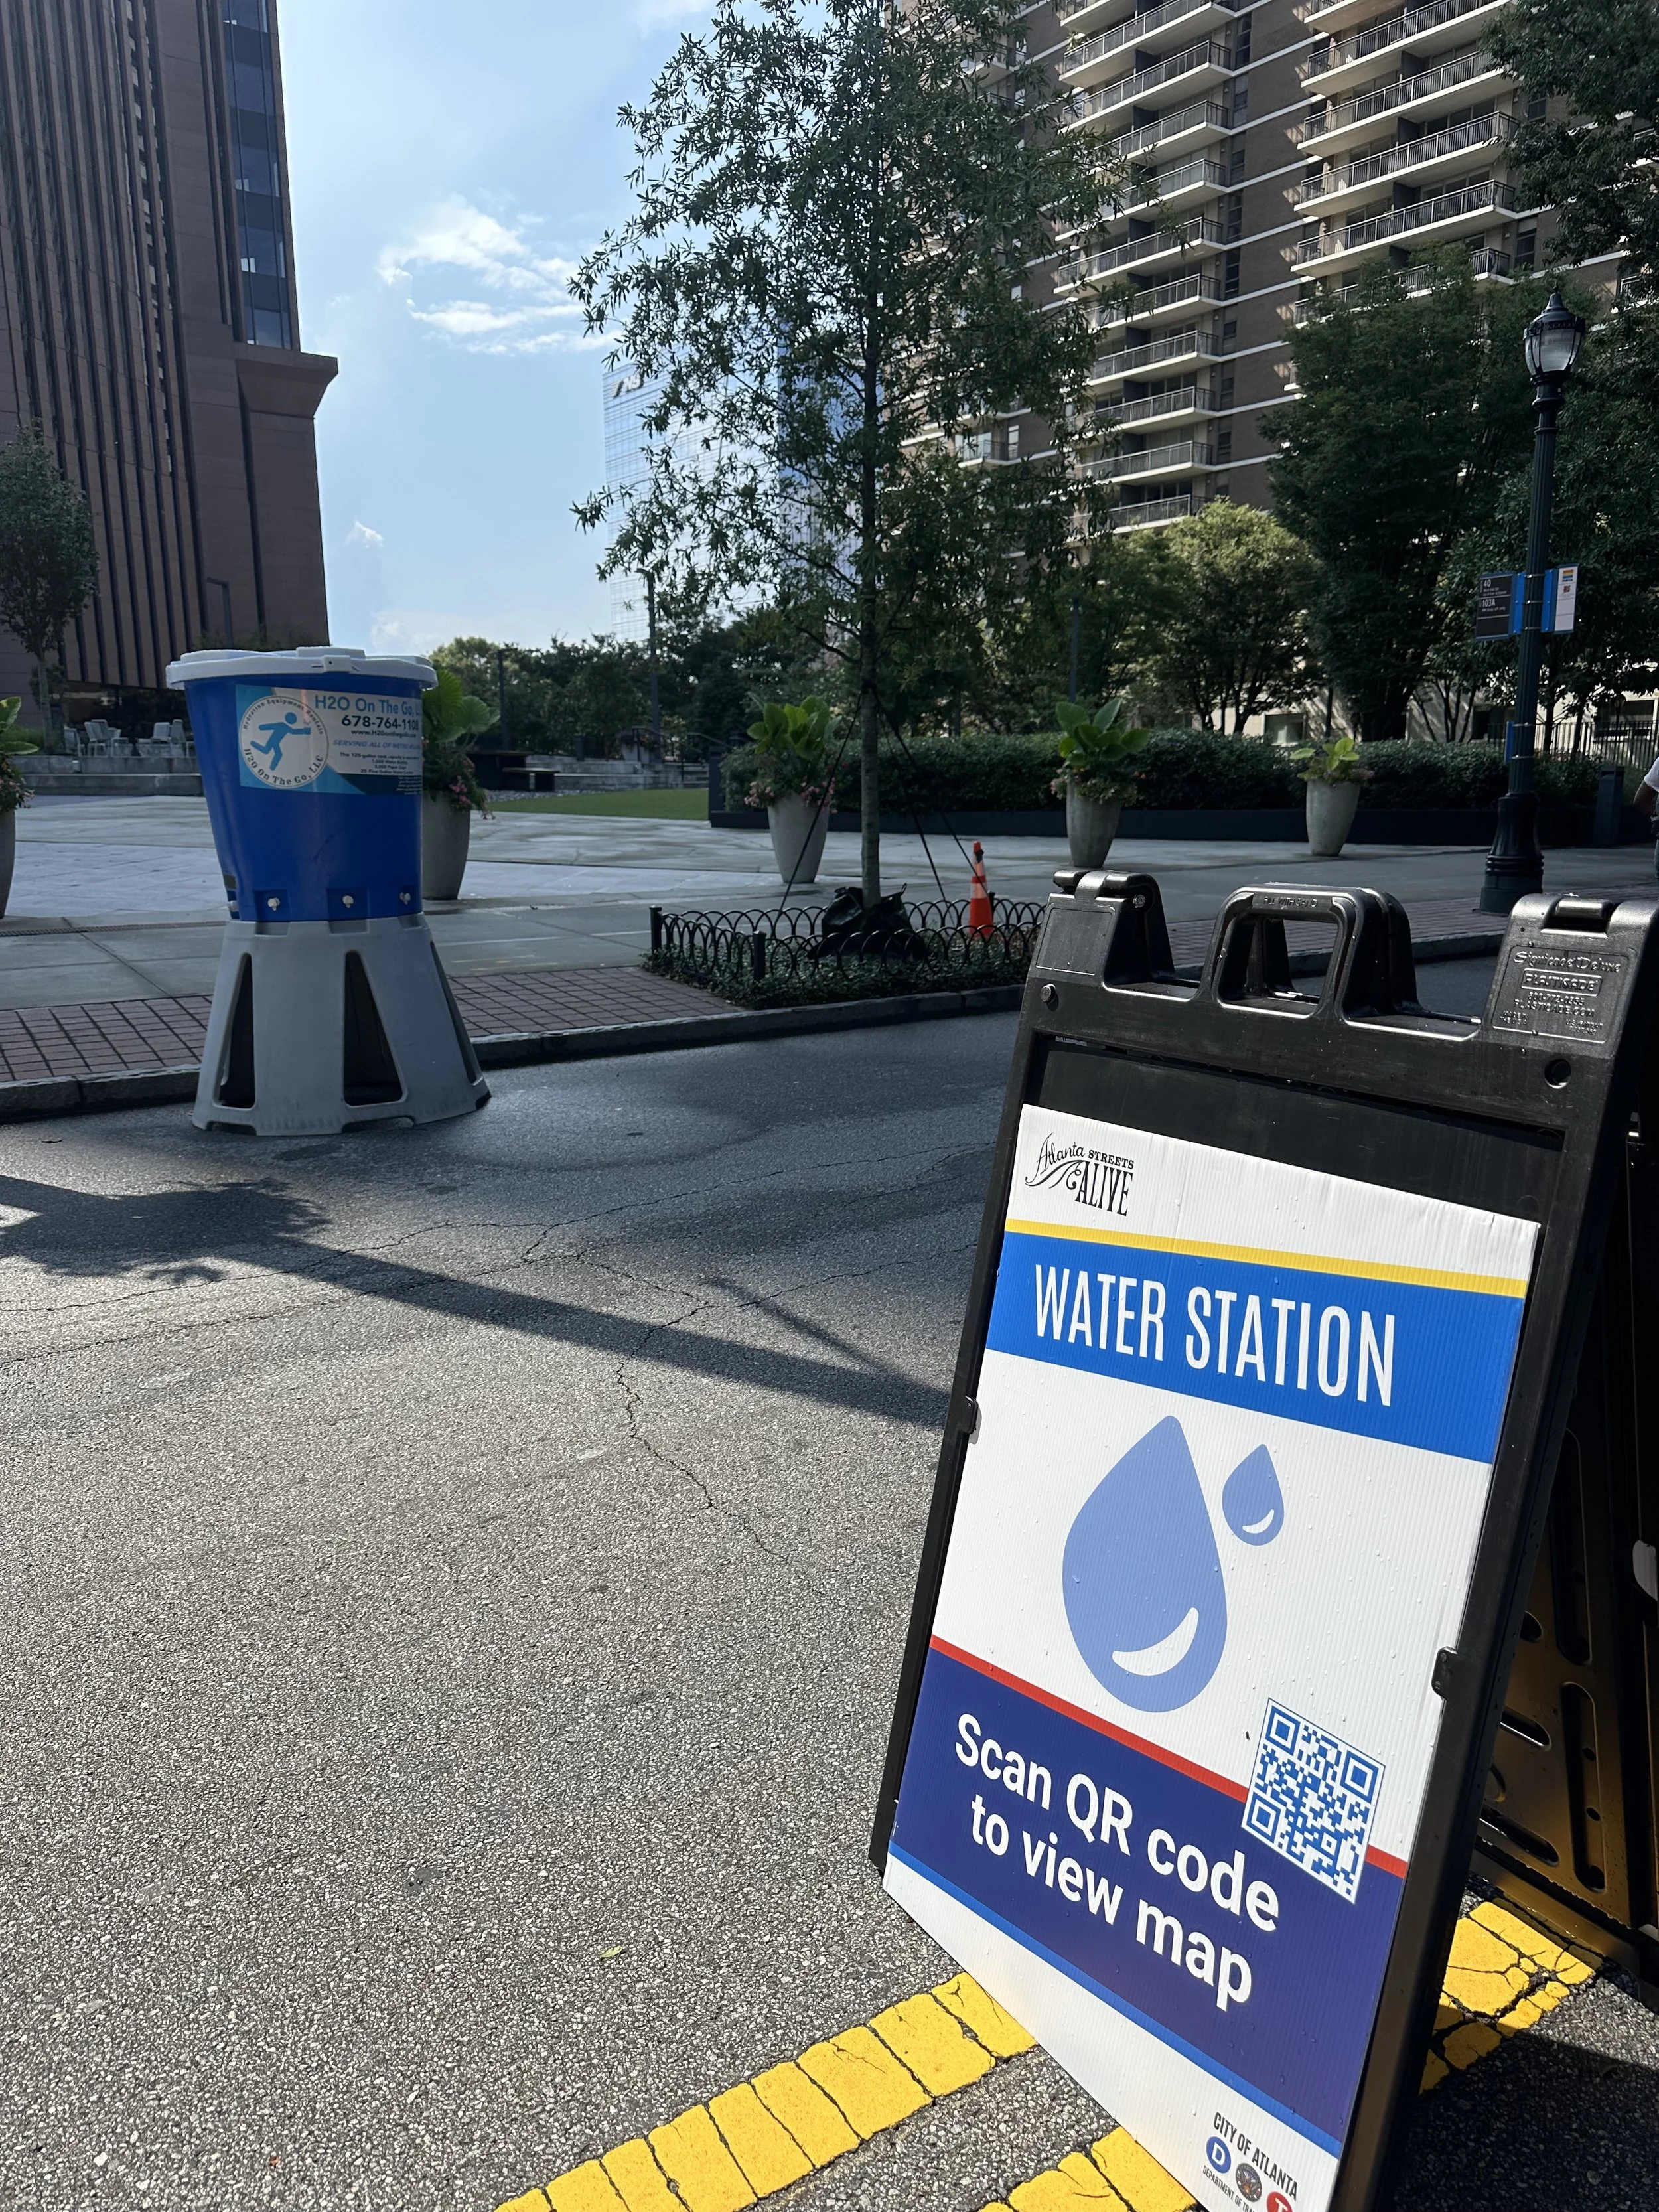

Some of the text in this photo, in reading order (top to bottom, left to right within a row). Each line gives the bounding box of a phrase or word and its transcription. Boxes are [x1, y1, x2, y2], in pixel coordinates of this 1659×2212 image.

[1482, 598, 1496, 607] 103A
[267, 698, 304, 711] Equipment
[315, 695, 350, 711] H2O
[355, 698, 375, 713] On
[378, 699, 398, 714] The
[257, 769, 270, 780] On
[272, 775, 292, 785] The
[309, 755, 324, 773] LLC
[1278, 897, 1296, 907] WITH
[1576, 956, 1621, 972] Deluxe
[1025, 1133, 1134, 1183] Atlanta STREETS
[1072, 1161, 1133, 1217] ALIVE
[1035, 1264, 1395, 1406] WATER STATION
[954, 1713, 1279, 1932] Scan QR code
[971, 1794, 1253, 2012] to view map
[1213, 2112, 1238, 2143] CITY
[1237, 2133, 1252, 2156] OF
[1252, 2147, 1298, 2201] ATLANTA
[1202, 2165, 1235, 2201] DEPARTMENT
[1234, 2195, 1243, 2207] OF
